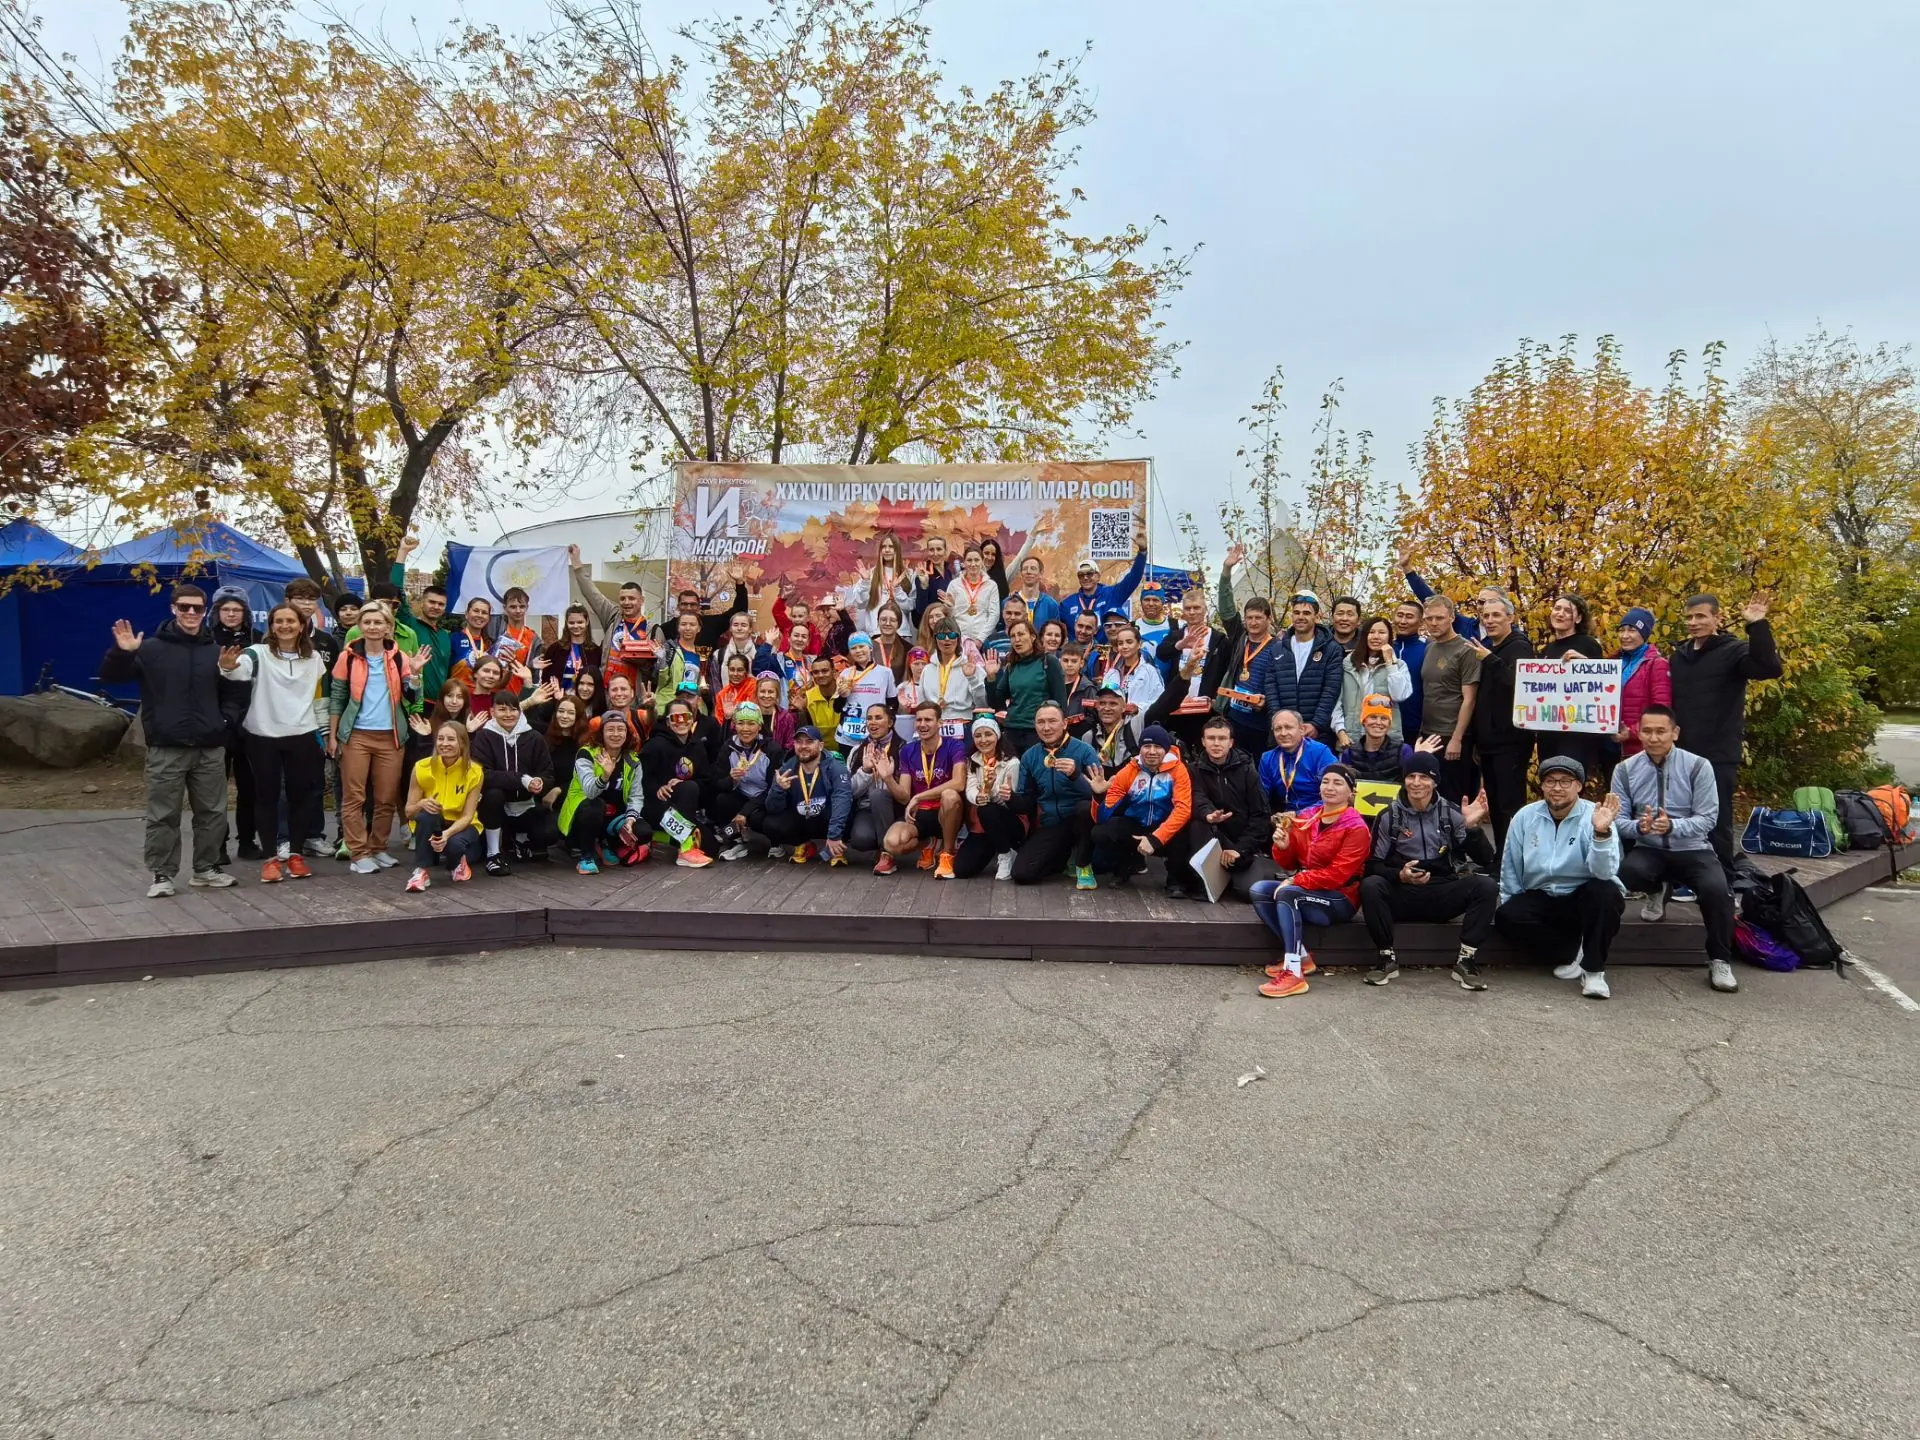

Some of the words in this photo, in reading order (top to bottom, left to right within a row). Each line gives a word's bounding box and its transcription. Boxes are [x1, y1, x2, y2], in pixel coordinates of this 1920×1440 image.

[839, 477, 945, 501] ИРКУТСКИЙ
[950, 476, 1032, 501] ОСЕННИЙ
[1038, 479, 1134, 500] МАРАФОН
[692, 538, 768, 555] МАРАФОН
[1519, 662, 1566, 674] ГОРЖУСЬ
[1572, 663, 1618, 675] КАЖДЫМ
[1522, 681, 1557, 693] ТВОИМ
[1564, 681, 1603, 693] ШАГОМ
[1515, 704, 1537, 722] ТЫ
[666, 816, 685, 835] 833
